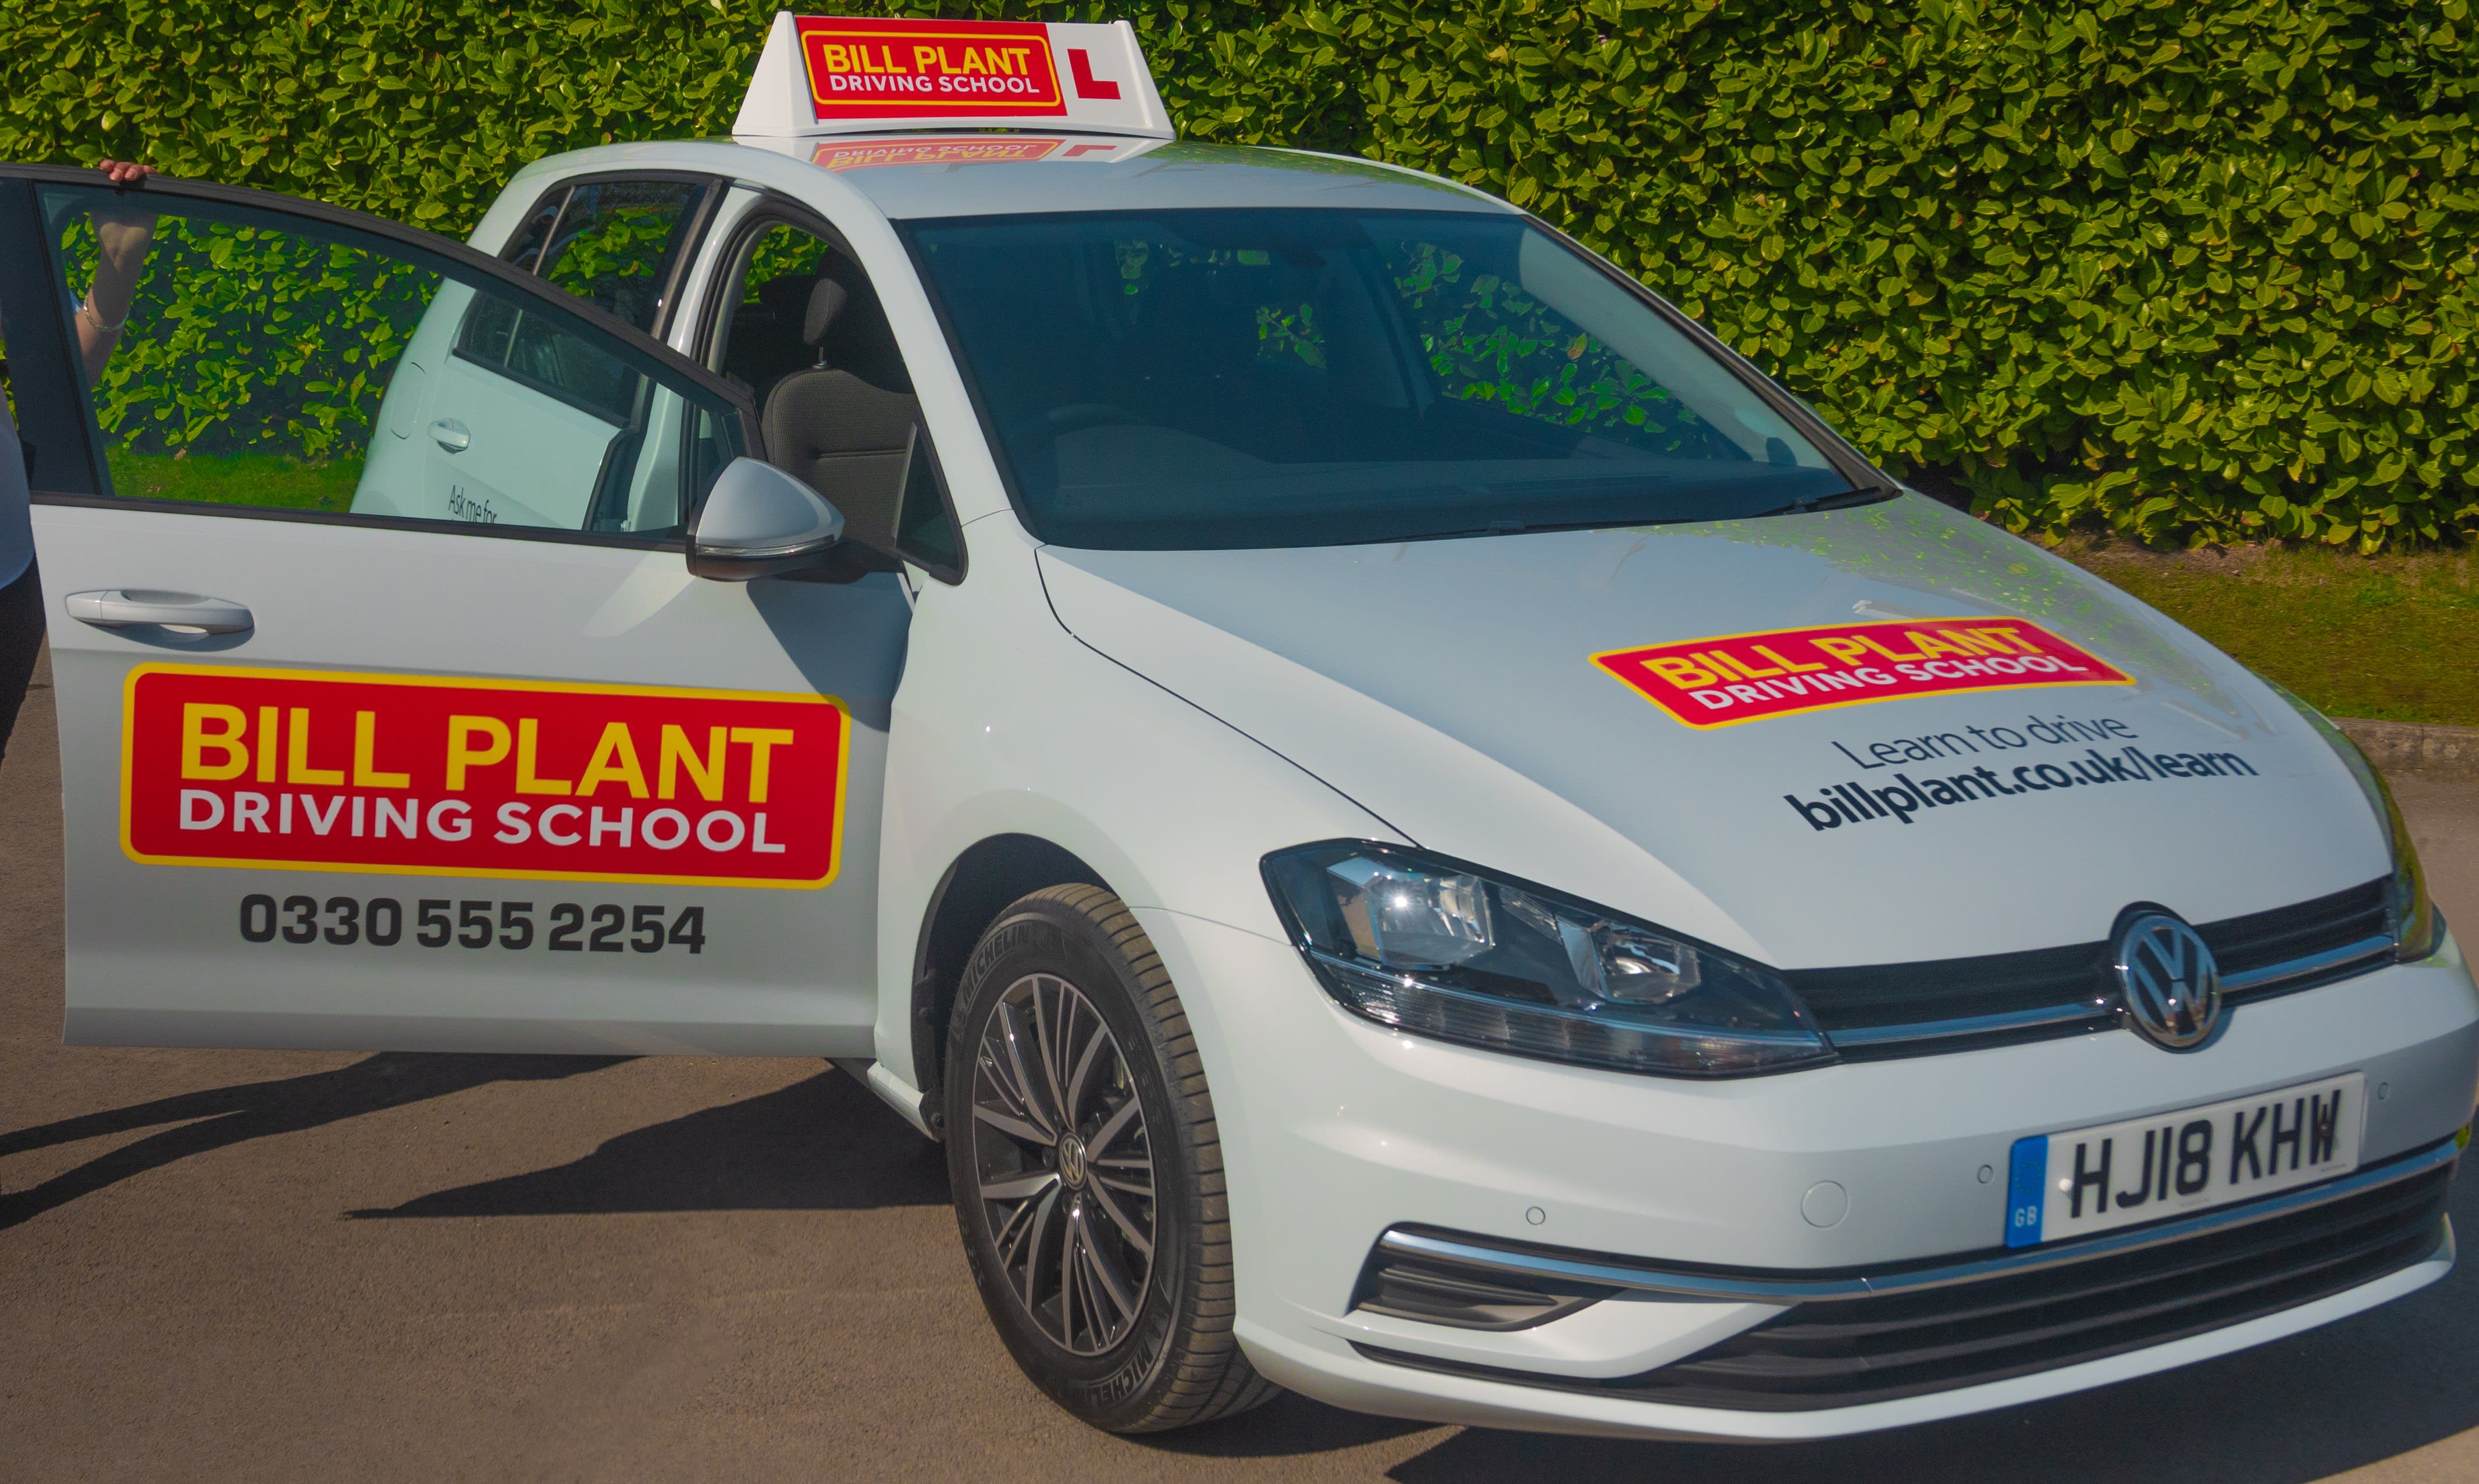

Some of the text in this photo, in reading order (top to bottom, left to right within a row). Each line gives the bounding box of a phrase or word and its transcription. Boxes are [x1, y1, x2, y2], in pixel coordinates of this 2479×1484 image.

[824, 45, 1030, 75] BILL PLANT
[830, 75, 1040, 93] DRIVING SCHOOL
[1067, 48, 1121, 100] L
[448, 484, 497, 524] Ask me for
[1640, 627, 2042, 689] BILL PLANT
[1689, 655, 2088, 709] DRIVING SCHOOL
[181, 703, 794, 803] BILL PLANT
[1831, 713, 2139, 769] Learn to drive
[1783, 745, 2259, 831] billplant.co.uk/learn
[179, 789, 786, 854] DRIVING SCHOOL
[240, 894, 706, 955] 0330 555 2254
[2071, 1089, 2341, 1219] HJ18 KHW
[2014, 1206, 2037, 1228] GB
[1075, 1339, 1153, 1407] MICHELI
